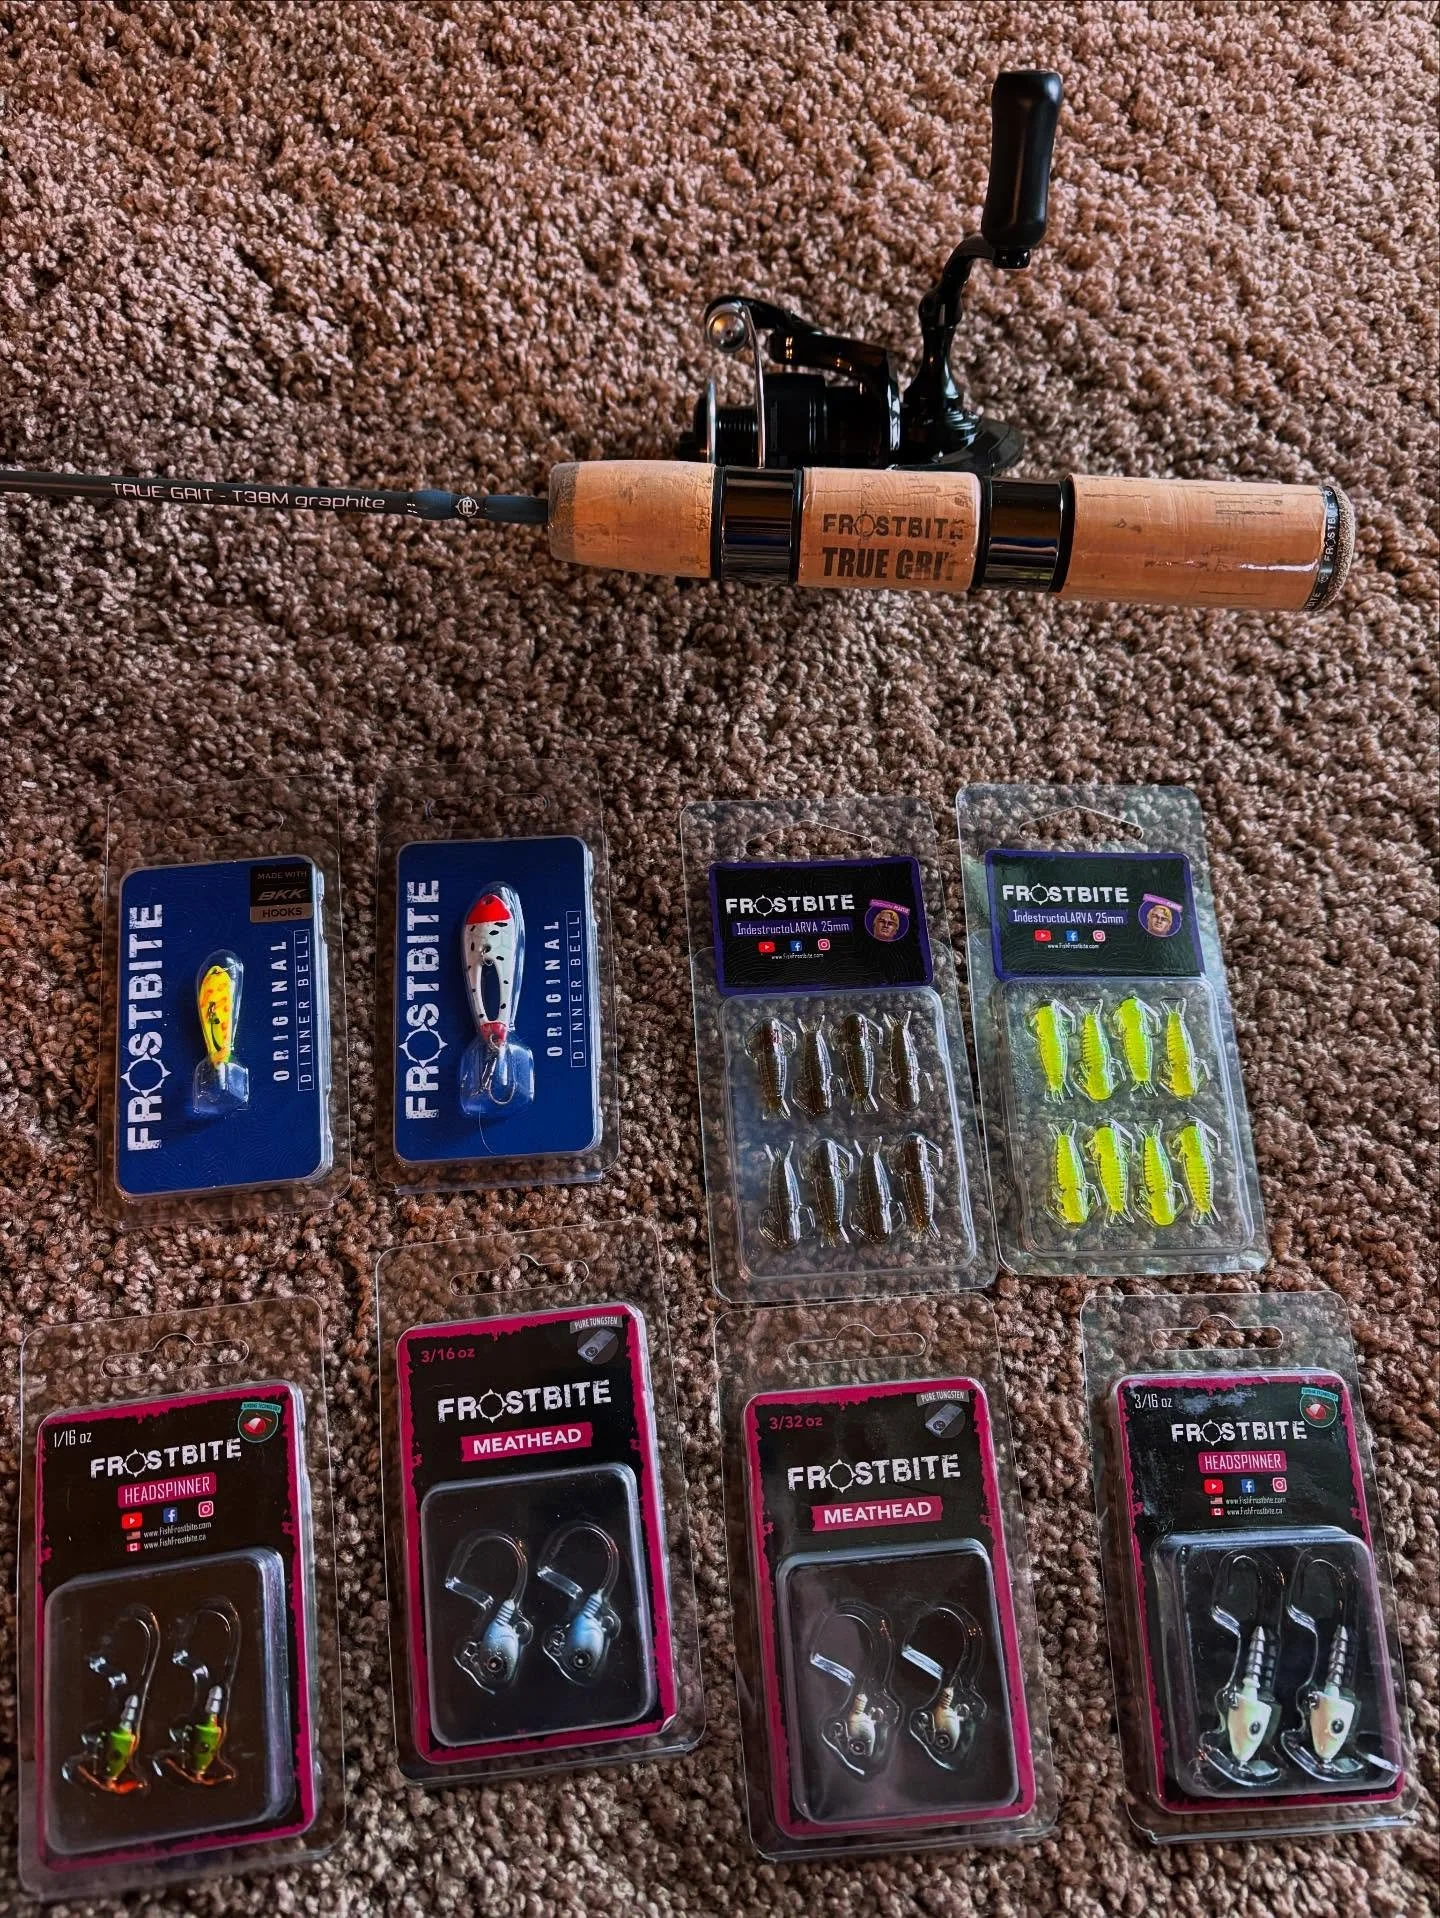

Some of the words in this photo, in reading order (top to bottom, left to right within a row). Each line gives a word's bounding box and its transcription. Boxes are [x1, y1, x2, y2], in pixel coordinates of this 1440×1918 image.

[111, 483, 165, 499] TRUE
[171, 486, 213, 501] GRIT
[232, 489, 288, 506] T38M
[295, 492, 386, 510] graphite
[822, 547, 890, 579] TRUE
[257, 872, 284, 880] MADE
[725, 894, 855, 916] FROSTBITE
[1002, 883, 1129, 905] FROSTBITE
[262, 907, 303, 918] HOOKS
[1013, 909, 1094, 924] IndestructoLARVA
[1095, 912, 1124, 924] 25mm
[736, 921, 818, 936] IndestructoLARVA
[820, 922, 850, 933] 25mm
[570, 916, 581, 967] BELL
[296, 935, 309, 987] BELL
[402, 880, 444, 1119] FROSTBITE
[543, 921, 564, 1057] ORIGINAL
[271, 941, 290, 1082] ORIGINAL
[571, 980, 585, 1060] DINNER
[124, 904, 167, 1151] FROSTBITE
[298, 1000, 312, 1083] DINNER
[574, 1318, 590, 1330] PURE
[590, 1316, 618, 1328] TUNGSTEN
[420, 1348, 454, 1364] 3/16
[458, 1347, 476, 1359] oz
[437, 1379, 612, 1423] FROSTBITE
[920, 1392, 936, 1402] PURE
[935, 1390, 965, 1401] TUNGSTEN
[1134, 1393, 1159, 1409] 3/16
[1161, 1397, 1173, 1409] oz
[768, 1415, 803, 1430] 3/32
[805, 1416, 824, 1428] oz
[1171, 1420, 1308, 1444] FROSTBITE
[53, 1430, 76, 1448] 1/16
[80, 1431, 92, 1444] oz
[473, 1428, 582, 1455] MEATHEAD
[90, 1438, 242, 1478] FROSTBITE
[1205, 1453, 1281, 1470] HEADSPINNER
[787, 1453, 961, 1493] FROSTBITE
[124, 1476, 210, 1505] HEADSPINNER
[823, 1501, 932, 1525] MEATHEAD
[143, 1521, 212, 1538] www.FishFrostbite.com
[143, 1534, 207, 1549] www.FishFrostbite.ca
